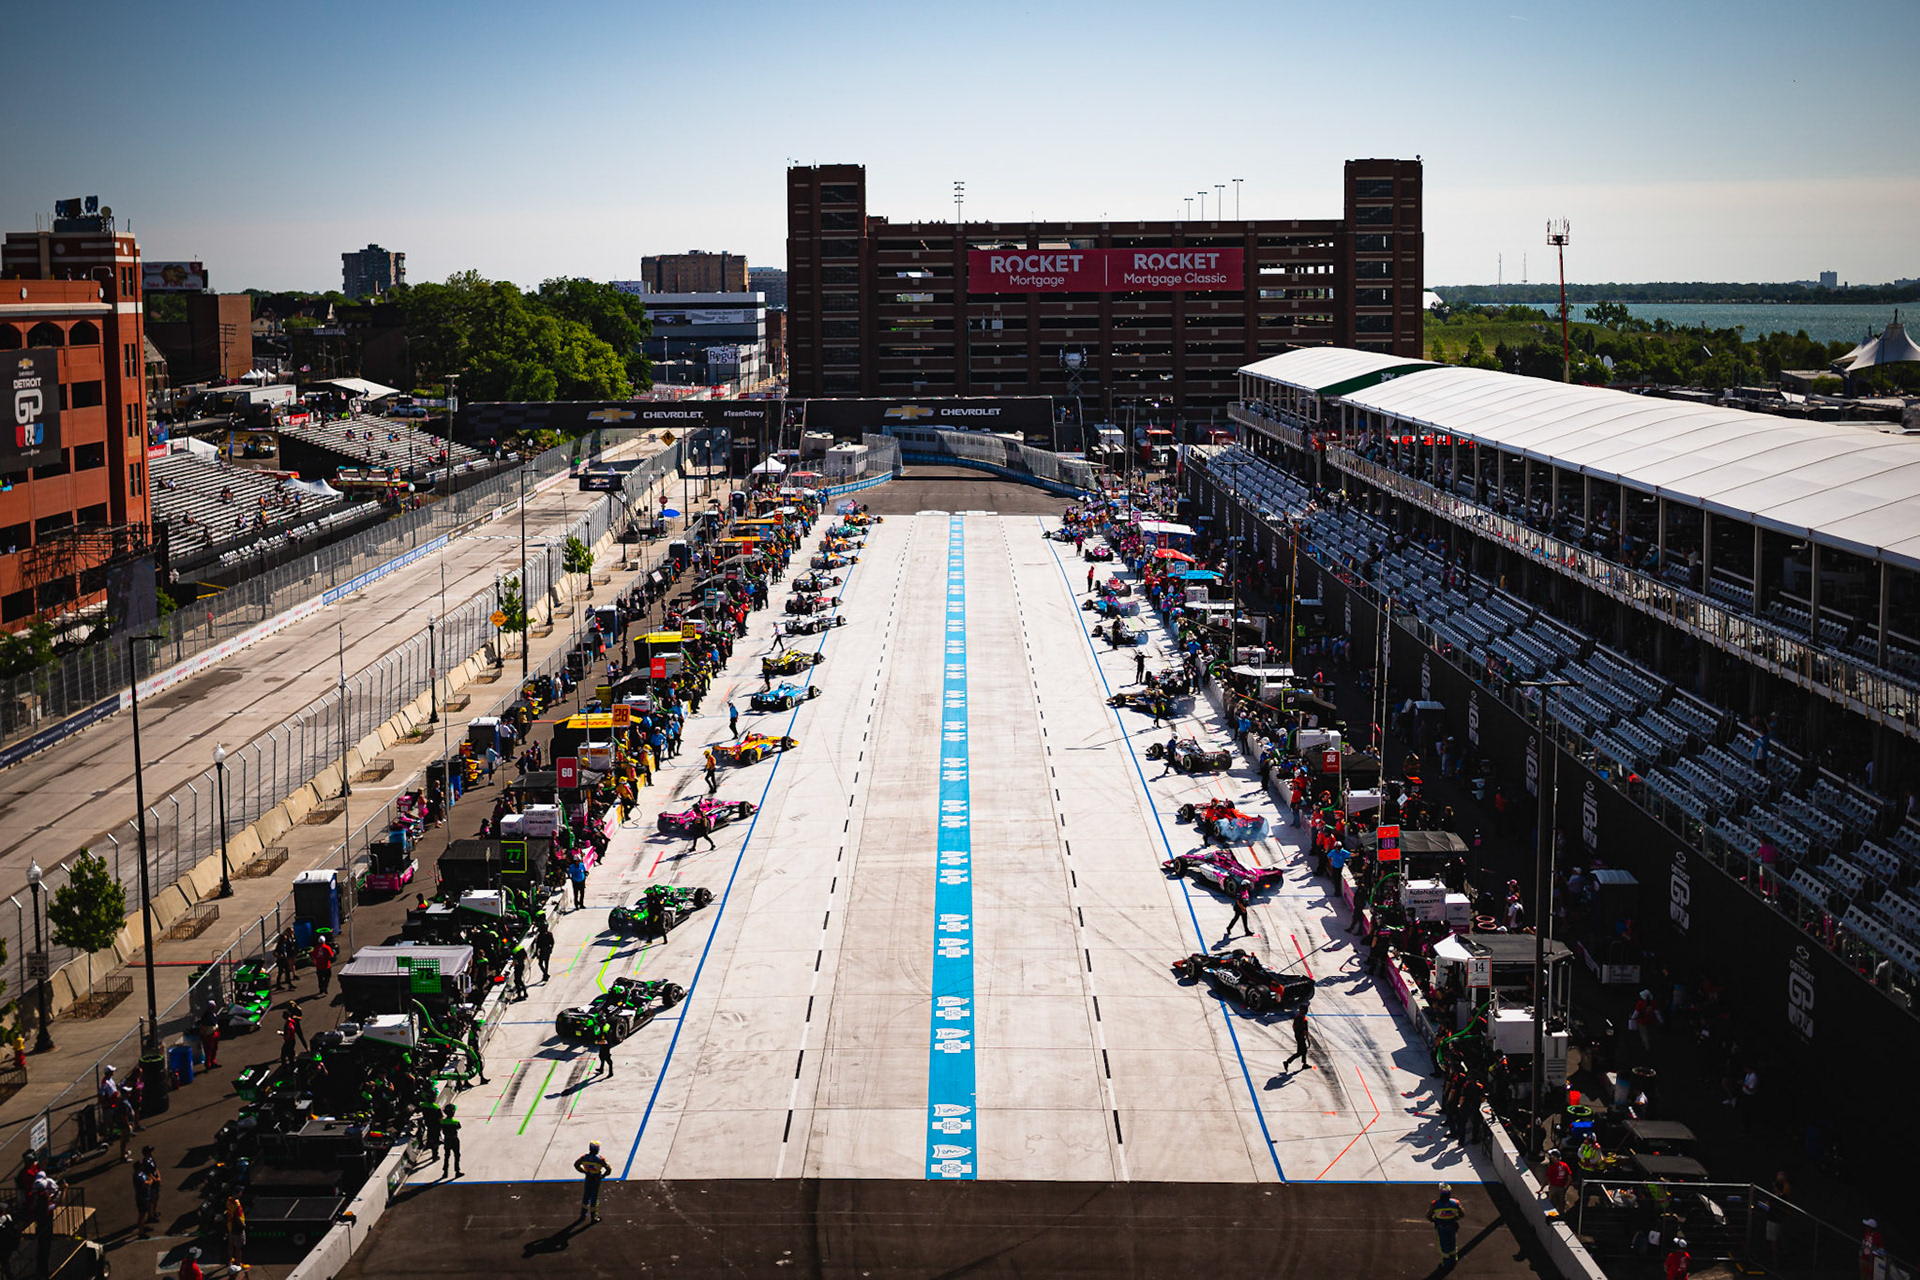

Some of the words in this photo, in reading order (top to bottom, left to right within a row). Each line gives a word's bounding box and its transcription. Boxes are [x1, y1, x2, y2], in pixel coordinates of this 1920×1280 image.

[990, 254, 1084, 273] ROCKET
[1134, 252, 1220, 270] ROCKET
[1009, 274, 1065, 287] Mortgage
[1124, 272, 1182, 286] Mortgage
[1184, 272, 1227, 284] Classic
[709, 351, 739, 364] Regus
[13, 377, 42, 389] DETROIT
[15, 388, 43, 424] GP
[941, 408, 1001, 416] CHEVROLET
[643, 411, 703, 419] CHEVROLET
[723, 410, 764, 418] #TeamChevy
[774, 514, 782, 522] 5
[761, 528, 769, 537] 7
[614, 708, 628, 722] 28
[1326, 754, 1336, 763] 55
[561, 768, 573, 778] 60
[506, 849, 522, 860] 77
[1671, 864, 1691, 882] DETROIT
[1409, 889, 1444, 897] AutoNation
[1474, 962, 1485, 972] 14
[1789, 960, 1816, 985] DETROIT
[1789, 971, 1815, 1011] GP
